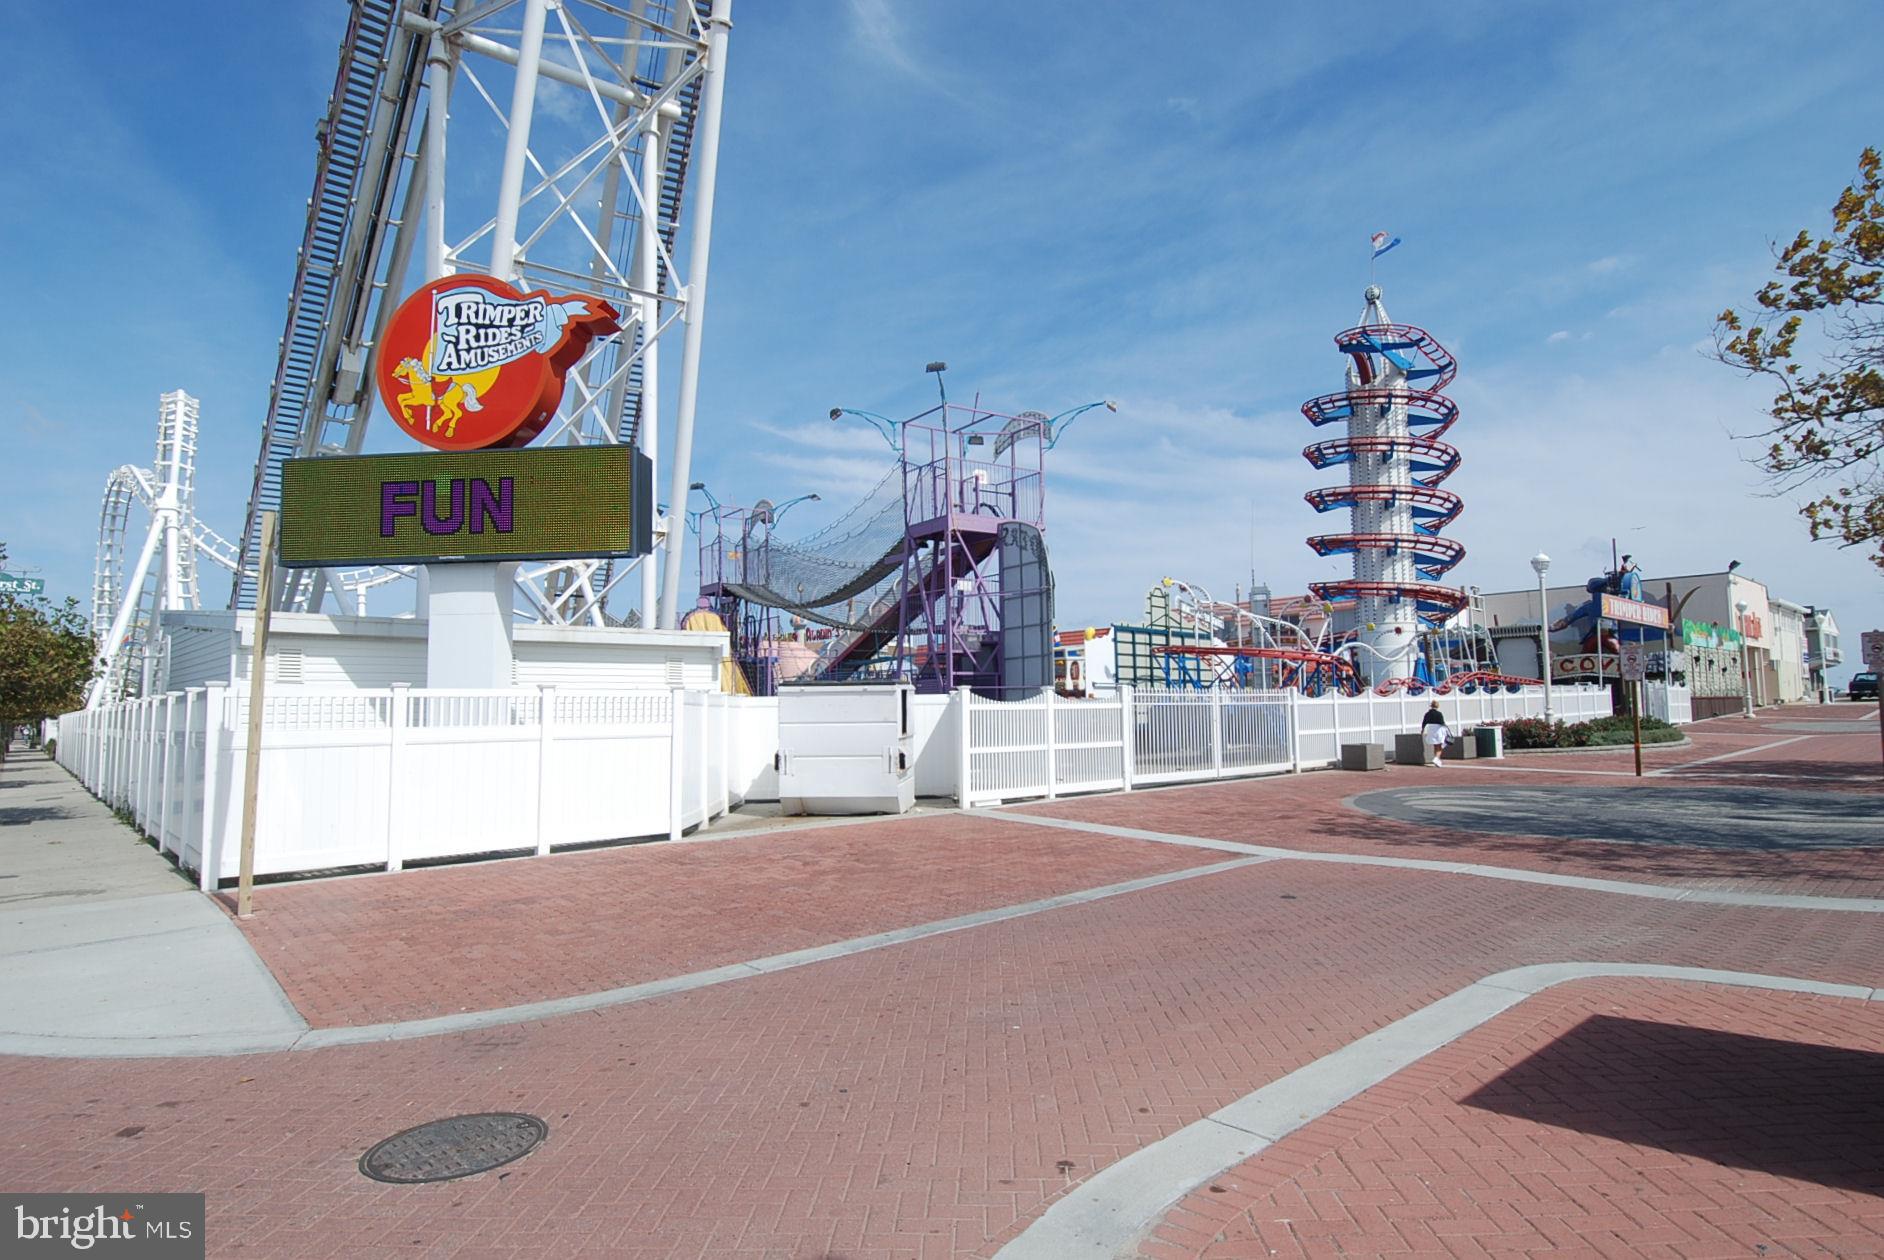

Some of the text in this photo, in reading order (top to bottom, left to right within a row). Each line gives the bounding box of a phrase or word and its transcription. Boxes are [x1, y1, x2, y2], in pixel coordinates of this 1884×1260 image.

[438, 293, 543, 326] TRIMPER
[438, 332, 543, 370] AMUSEMENTS
[457, 325, 522, 349] RIDES
[380, 477, 514, 538] FUN
[1559, 656, 1620, 672] COV
